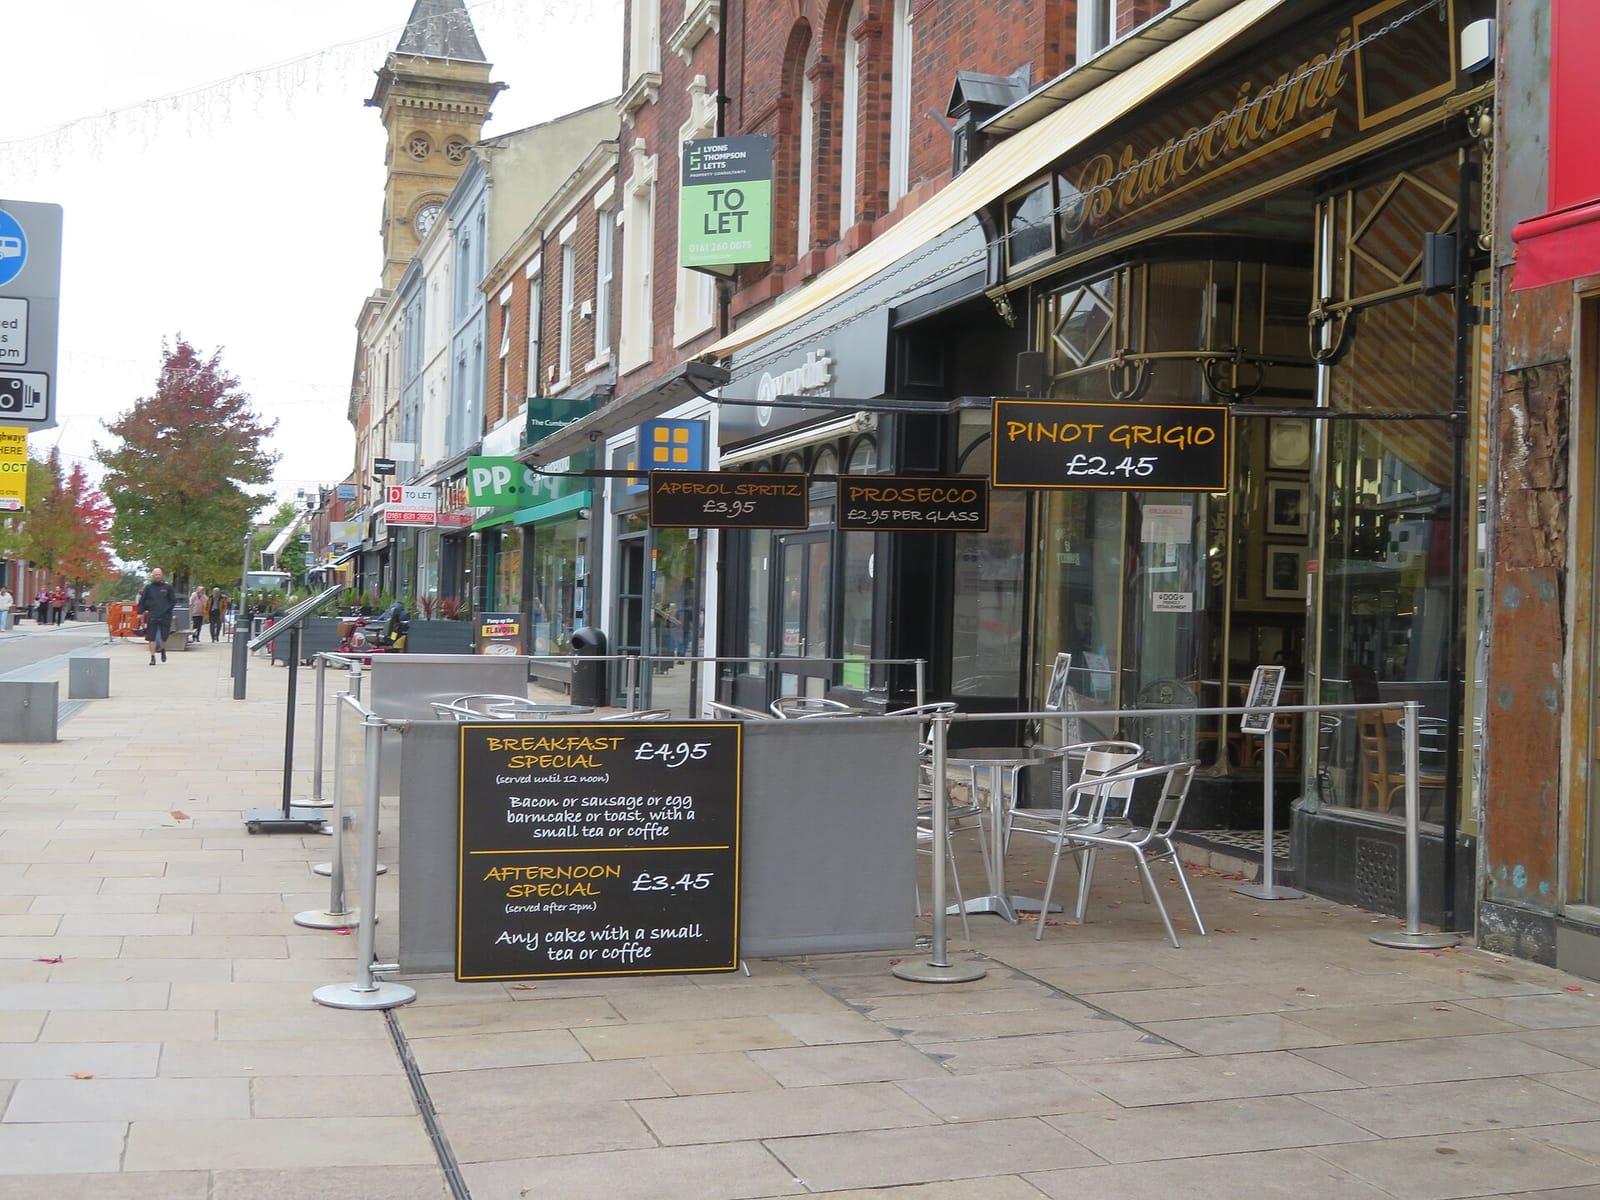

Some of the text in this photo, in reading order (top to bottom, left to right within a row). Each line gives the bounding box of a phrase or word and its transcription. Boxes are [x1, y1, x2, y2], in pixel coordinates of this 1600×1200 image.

[1062, 27, 1350, 235] Brucciani
[703, 144, 728, 153] LYONS
[703, 152, 747, 161] THOMPSON
[690, 147, 701, 171] LTL
[703, 162, 726, 170] LETTS
[707, 188, 745, 211] TO
[703, 211, 749, 235] LET
[0, 318, 18, 329] ed
[531, 418, 544, 426] The
[1007, 421, 1216, 451] PINOT GRIGIO
[2, 462, 27, 472] OCT
[1066, 453, 1159, 478] £2.45
[405, 491, 416, 499] TO
[417, 492, 433, 500] LET
[656, 481, 733, 497] APEROL
[849, 485, 978, 504] PROSECCO
[702, 499, 757, 519] £3.95
[847, 508, 980, 525] £2.95 PER GLASS
[486, 736, 625, 752] BREAKFAST
[507, 754, 603, 769] SPECIAL
[634, 742, 712, 768] £4.95
[495, 773, 610, 785] (served until 12 noon)
[509, 796, 692, 810] Bacon or sausage or egg
[507, 806, 695, 824] barmcake or toast, with a
[533, 822, 670, 841] small tea or coffee
[483, 864, 622, 881] AFTERNOON
[505, 882, 601, 898] SPECIAL
[632, 871, 714, 892] £3.45
[504, 901, 597, 914] (served after 2pm)
[495, 923, 702, 950] Any cake with a small
[547, 942, 652, 963] tea or coffee
